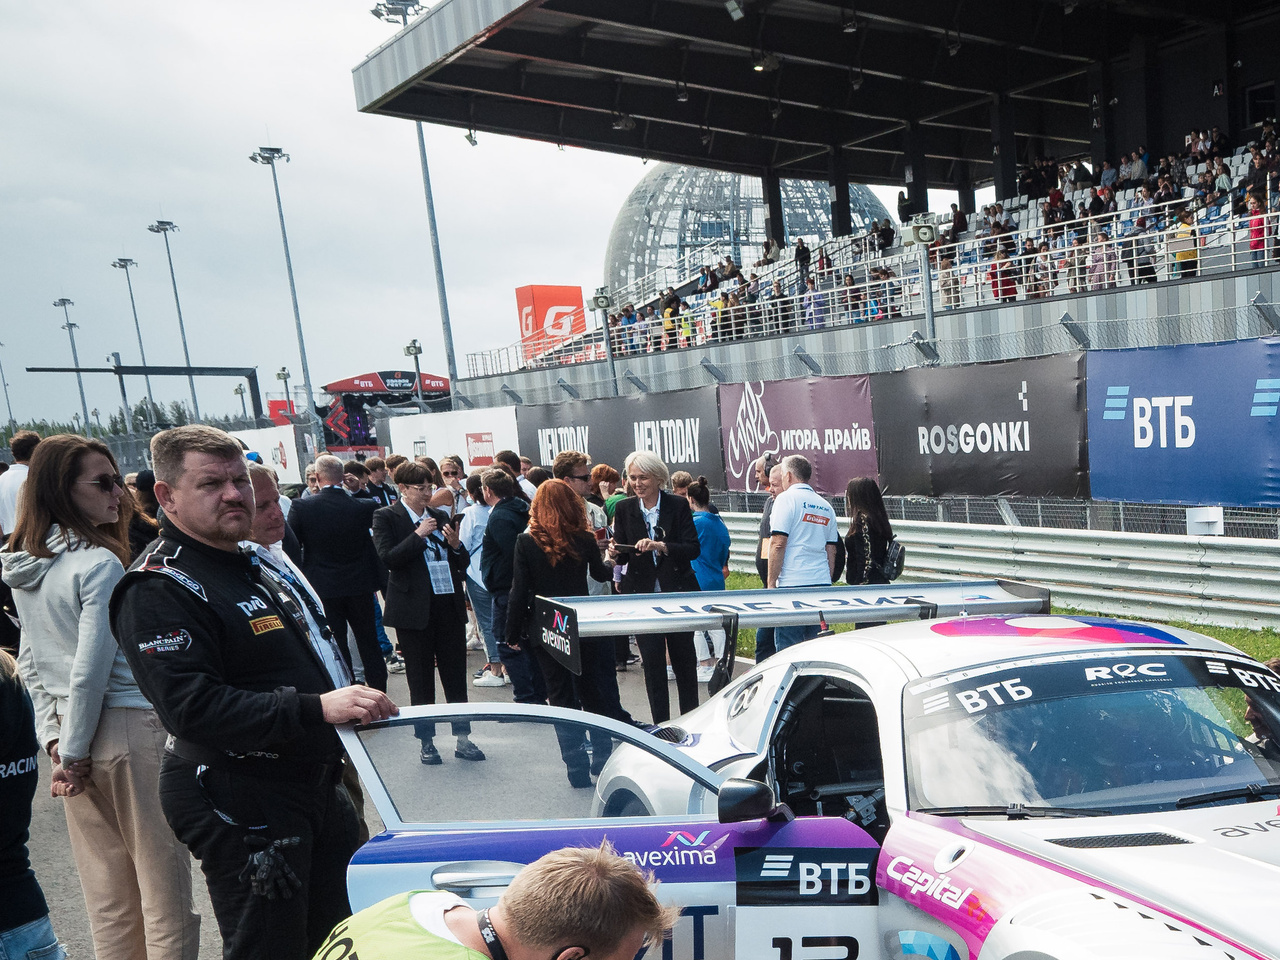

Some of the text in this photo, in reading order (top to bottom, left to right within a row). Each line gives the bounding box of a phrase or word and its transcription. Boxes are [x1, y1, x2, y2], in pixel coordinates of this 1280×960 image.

[781, 422, 872, 454] ИГОРА ДРАЙВ
[917, 421, 1030, 454] ROSGONKI
[1133, 396, 1196, 449] ВТБ
[634, 417, 700, 464] MEN TODAY
[138, 635, 184, 650] BLANCPAIN
[542, 627, 571, 656] avexima
[955, 677, 1033, 715] ВТБ
[0, 755, 38, 779] RACIN
[623, 846, 717, 867] avexima
[799, 862, 871, 895] ВТБ
[886, 855, 974, 910] Capital
